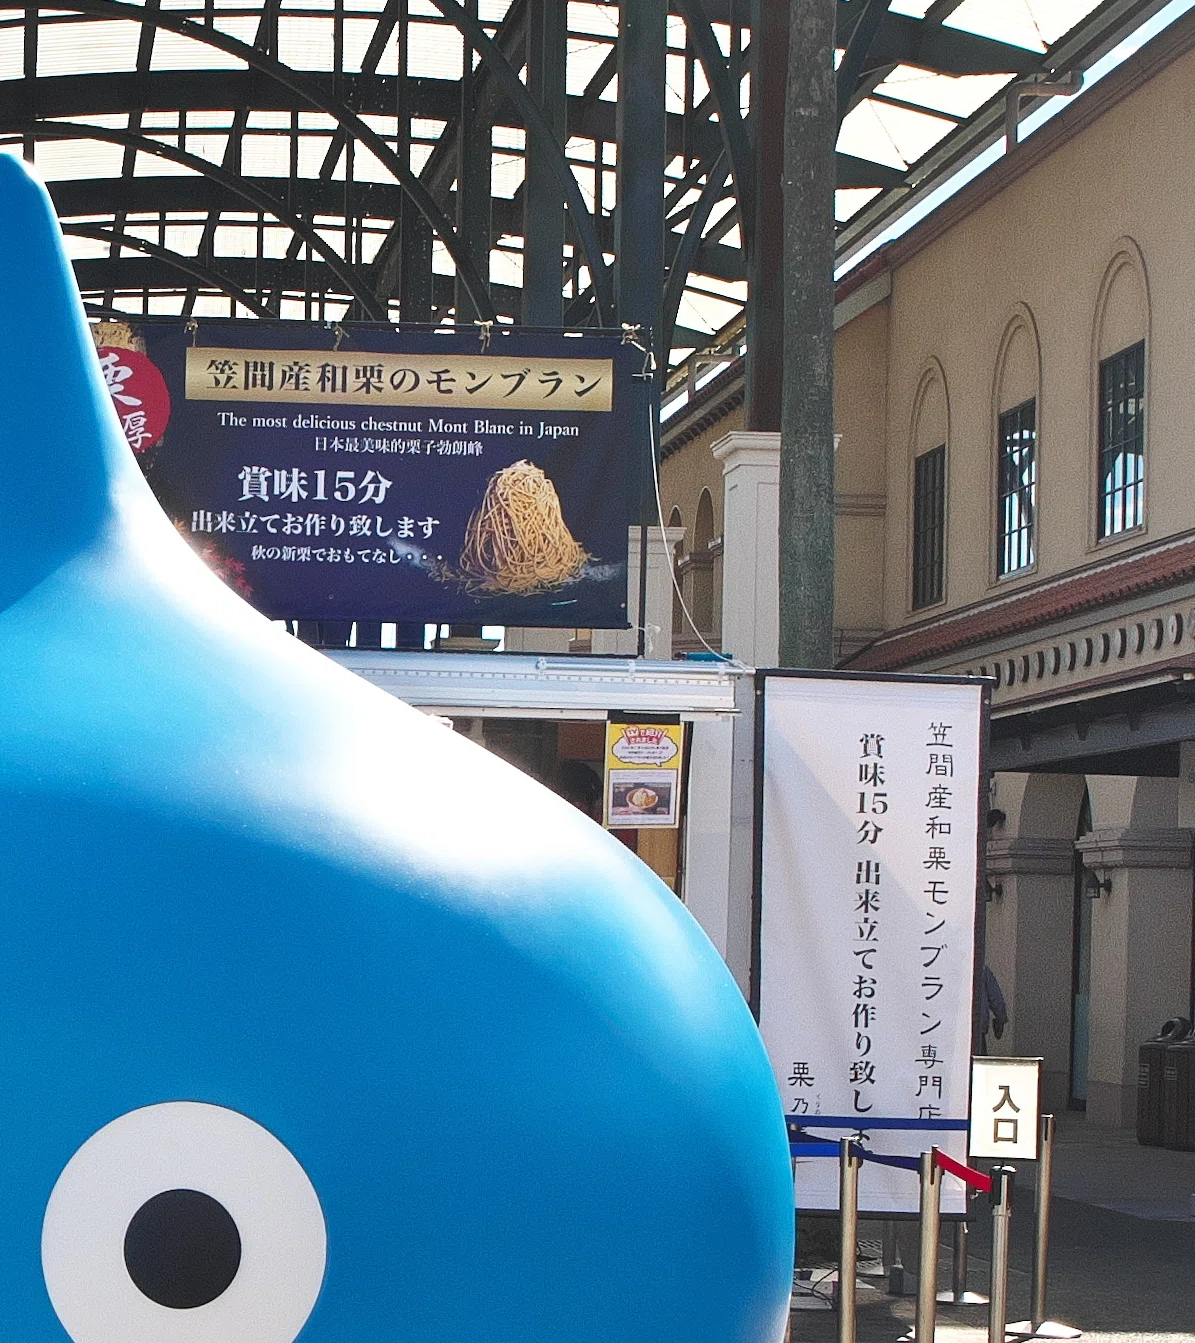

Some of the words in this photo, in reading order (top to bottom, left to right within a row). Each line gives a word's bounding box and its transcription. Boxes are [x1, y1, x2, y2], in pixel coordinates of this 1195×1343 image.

[206, 359, 602, 399] 笠間産和栗のモンブラン
[217, 411, 247, 427] The
[252, 414, 288, 428] most
[292, 414, 356, 430] delicious
[360, 416, 423, 433] chestnut
[428, 418, 468, 434] Mont
[474, 420, 513, 435] Blanc
[519, 421, 533, 435] in
[537, 422, 579, 440] Japan
[315, 436, 483, 457] 日本最美味的栗子勃朗峰
[237, 465, 393, 504] 賞味15分
[191, 510, 440, 540] 出来立てお作り致します
[856, 733, 888, 845] 賞味15分
[849, 859, 882, 1153] 出来立てお作り致し
[992, 1085, 1020, 1144] 入口
